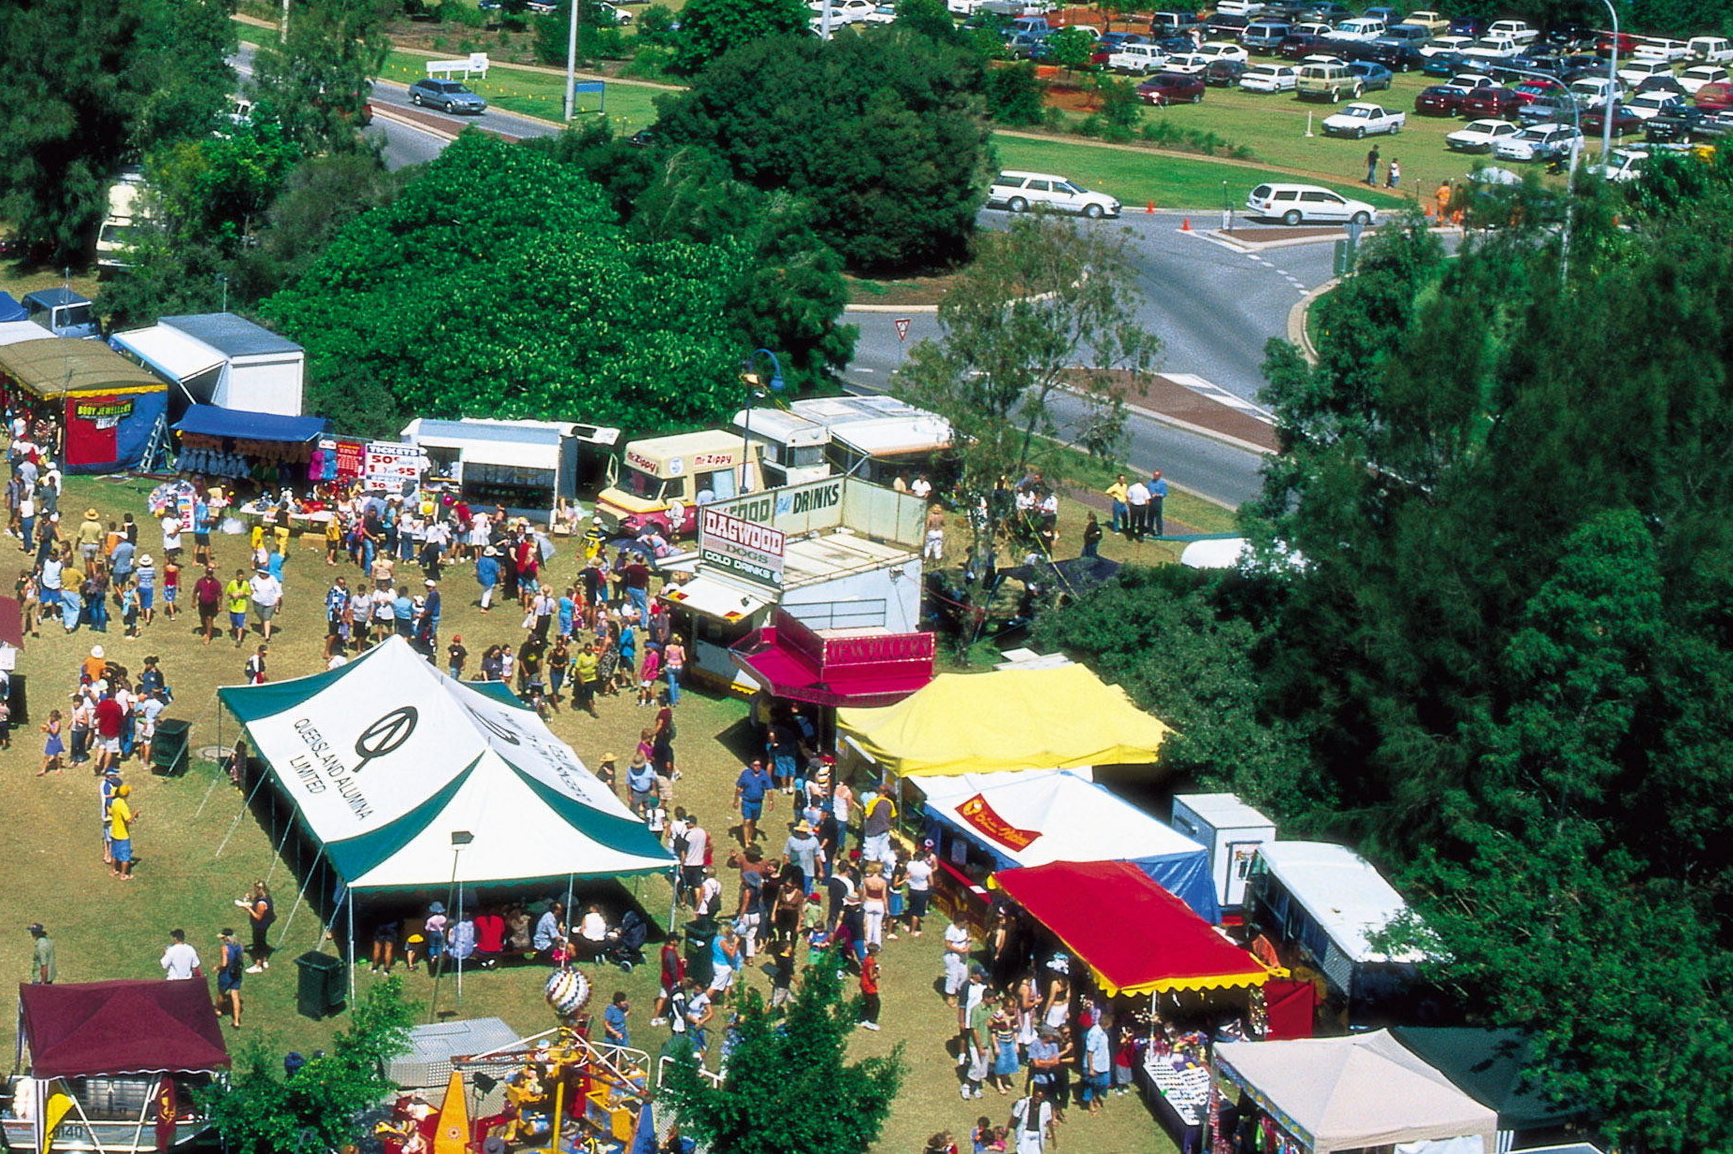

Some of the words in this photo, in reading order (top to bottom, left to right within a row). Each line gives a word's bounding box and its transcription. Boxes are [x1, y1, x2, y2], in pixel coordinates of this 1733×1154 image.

[368, 446, 418, 456] TICKETS
[635, 454, 657, 473] Zippy
[694, 456, 705, 465] Mr
[707, 454, 732, 465] Zippy
[793, 483, 840, 515] DRINKS
[705, 511, 784, 554] DAGWOOD
[704, 551, 731, 566] COLD
[733, 560, 771, 578] DRINKS
[725, 542, 769, 564] DOGS
[827, 636, 930, 663] JEWELLERY
[290, 754, 327, 794] LIMITED
[294, 718, 345, 778] QUEENSLAND
[333, 776, 374, 821] ALUMINA
